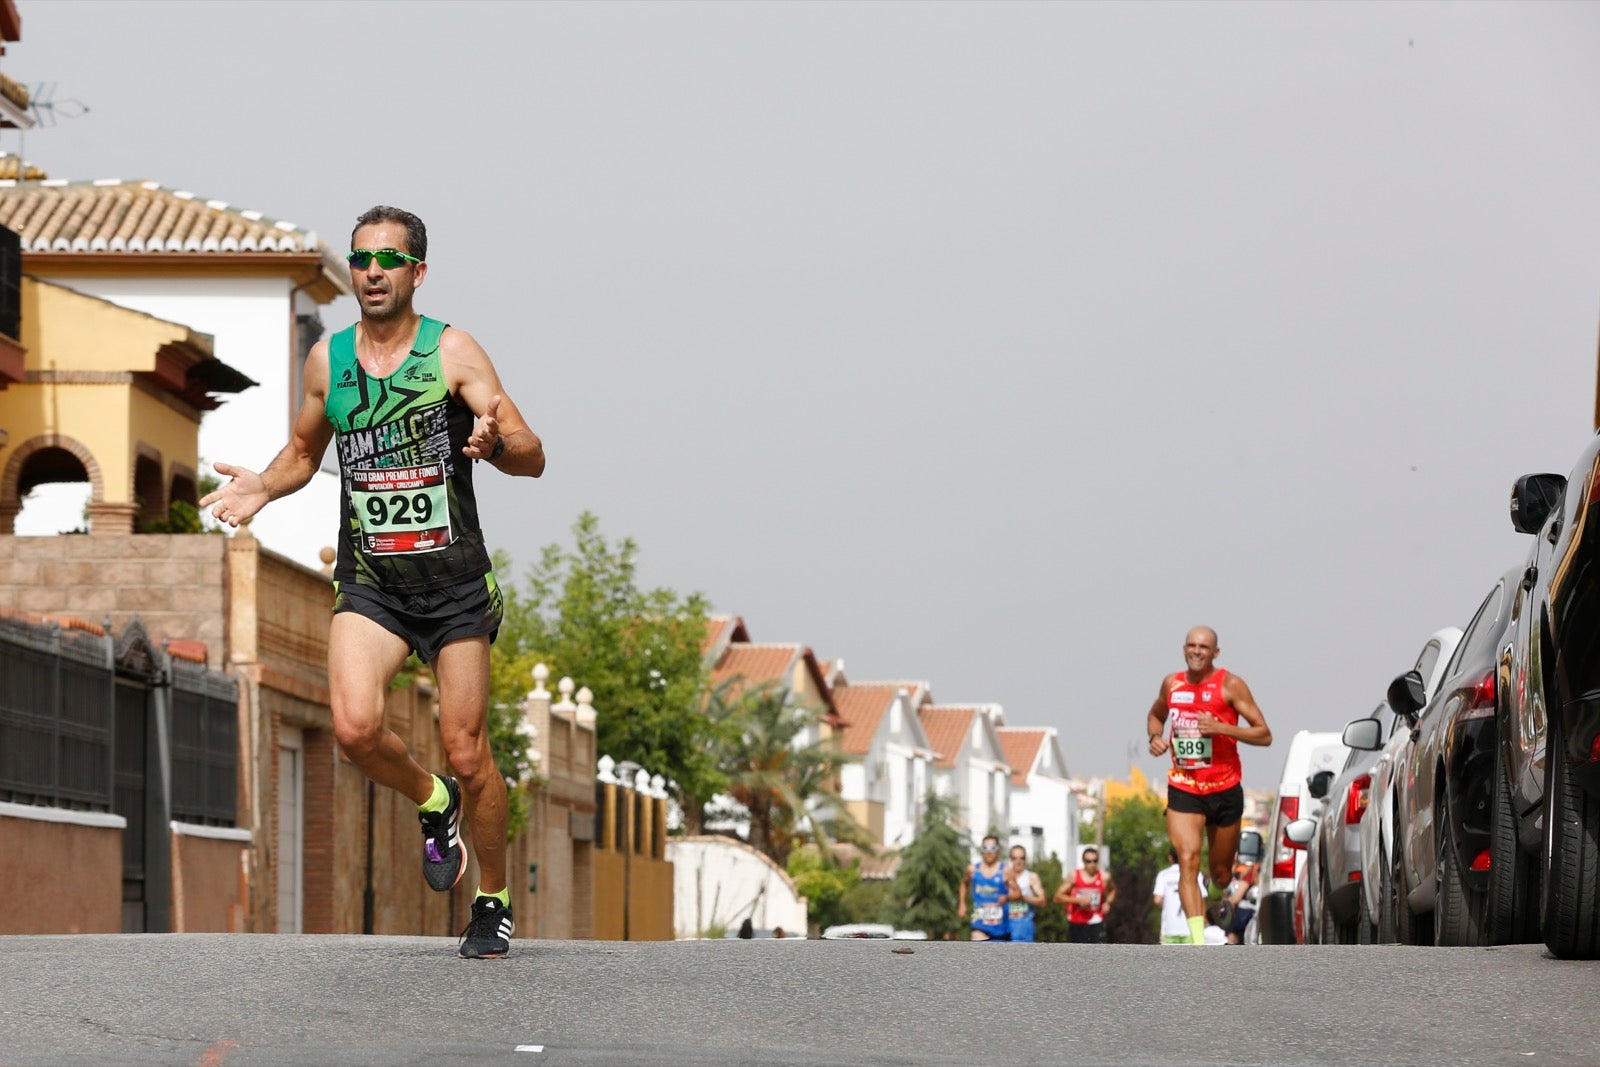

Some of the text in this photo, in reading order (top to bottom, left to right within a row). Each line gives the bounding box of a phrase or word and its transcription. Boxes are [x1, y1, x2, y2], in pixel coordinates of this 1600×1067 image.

[340, 430, 374, 464] EAM
[368, 472, 385, 482] GRAN
[386, 469, 409, 481] PREMIO
[410, 469, 419, 480] DE
[419, 466, 438, 479] FONDO
[366, 493, 433, 526] 929
[1178, 741, 1205, 755] 589
